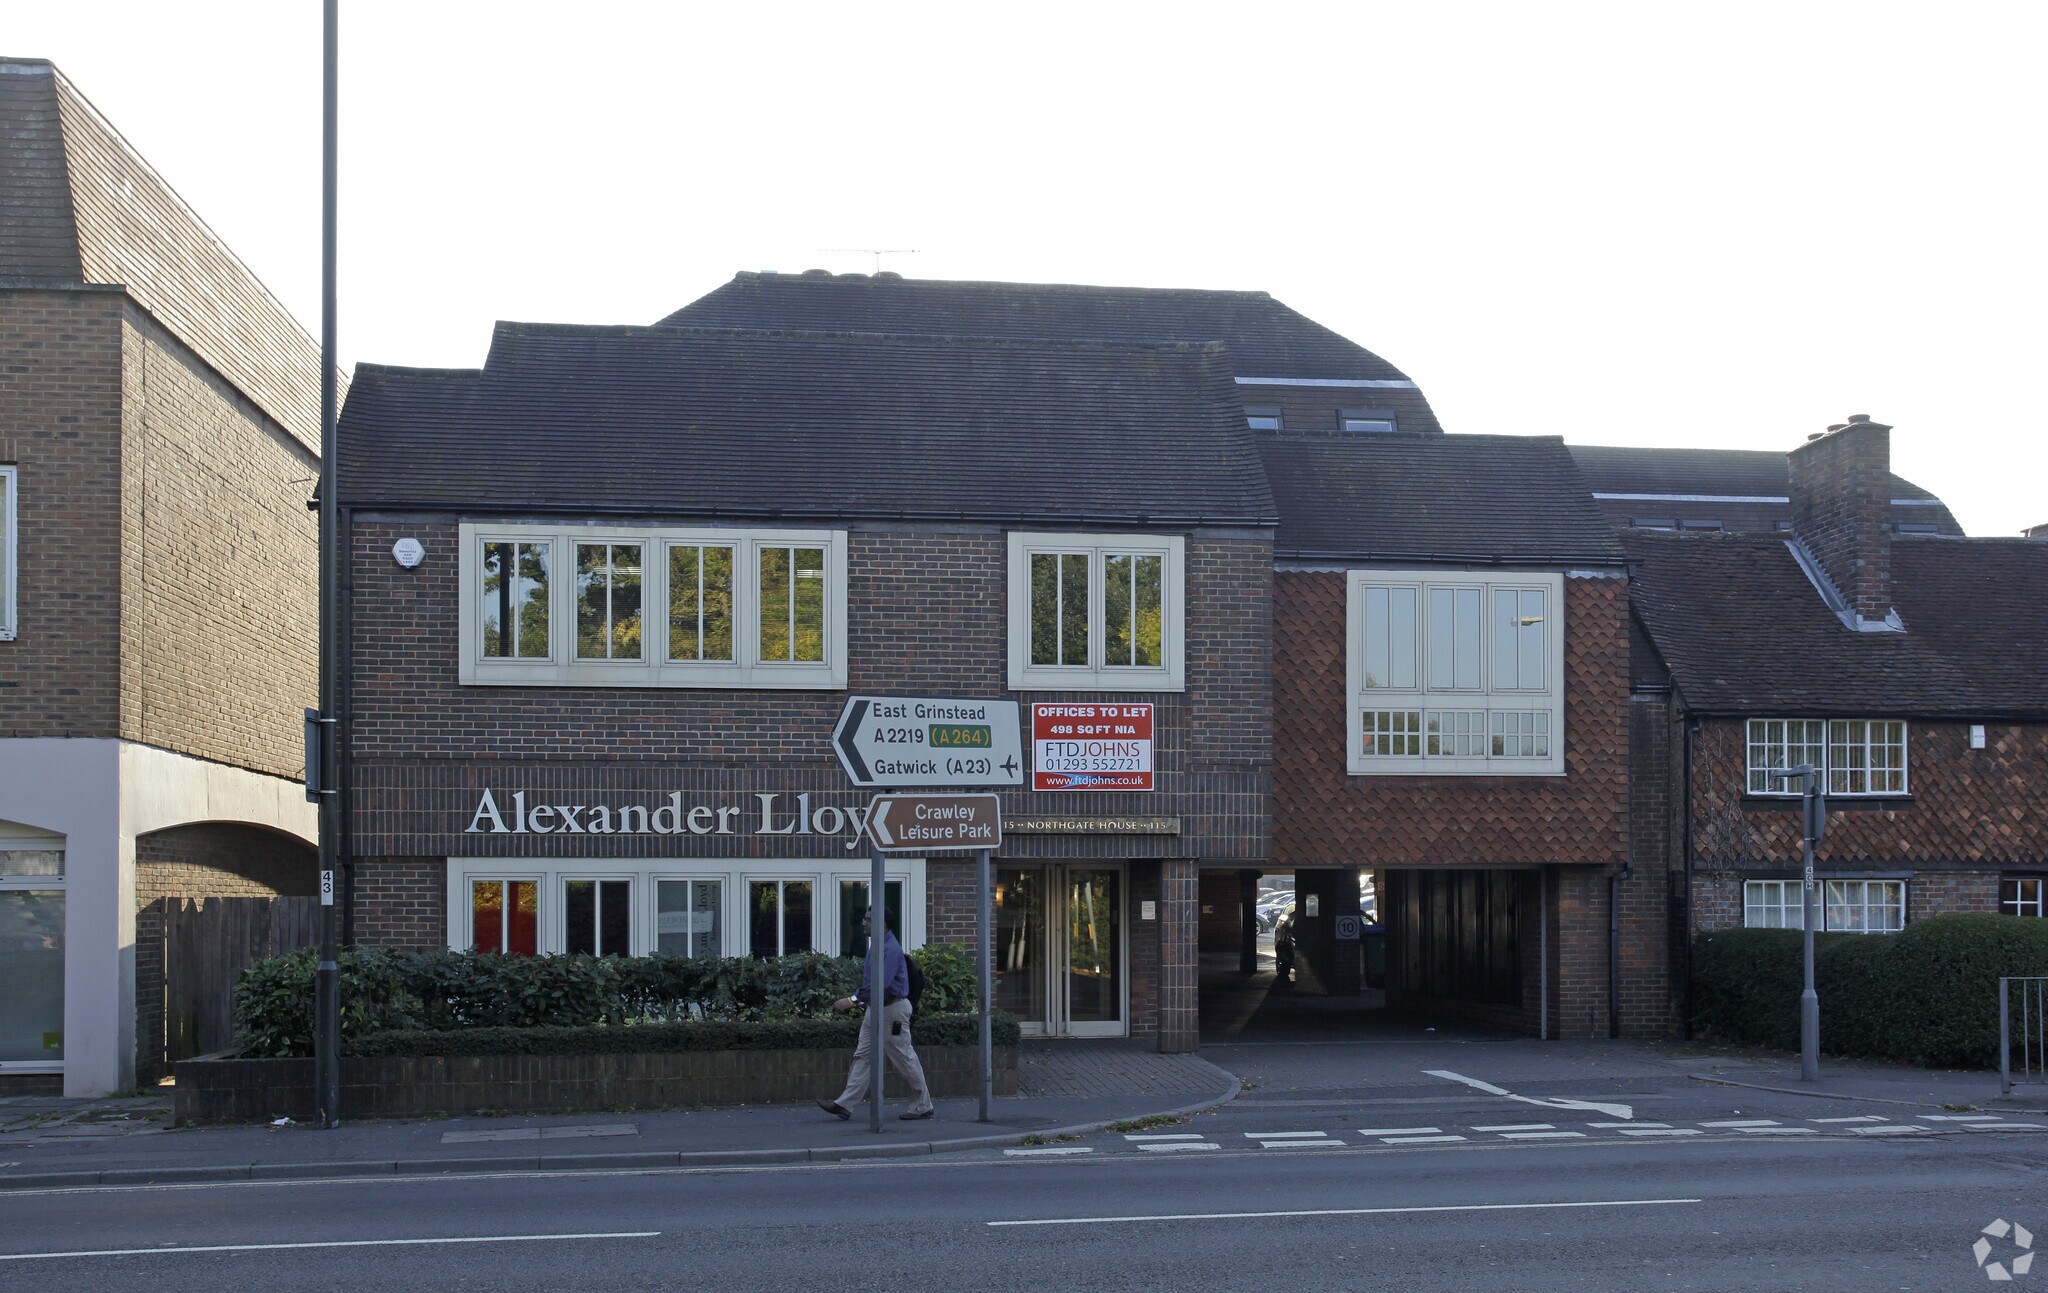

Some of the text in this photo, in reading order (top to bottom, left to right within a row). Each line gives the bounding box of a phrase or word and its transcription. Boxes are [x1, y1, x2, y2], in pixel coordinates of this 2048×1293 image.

[873, 702, 986, 720] East Grinstead
[1038, 707, 1148, 717] OFFICES TO LET
[874, 727, 990, 747] A2219 (A264)
[1050, 725, 1073, 734] 498
[1115, 725, 1136, 734] NIA
[1045, 742, 1140, 757] FTDJOHNS
[874, 757, 991, 776] Gatwick (A23)
[1046, 758, 1140, 771] 01293 552721
[1046, 776, 1143, 787] www.ftdjohns.co.uk
[464, 787, 870, 850] Alexander Lloy
[915, 803, 975, 822] Crawley
[899, 822, 992, 840] Leisure Park
[1003, 821, 1166, 830] 15 NORTHGATE HOUSE 115
[1341, 922, 1354, 933] 10
